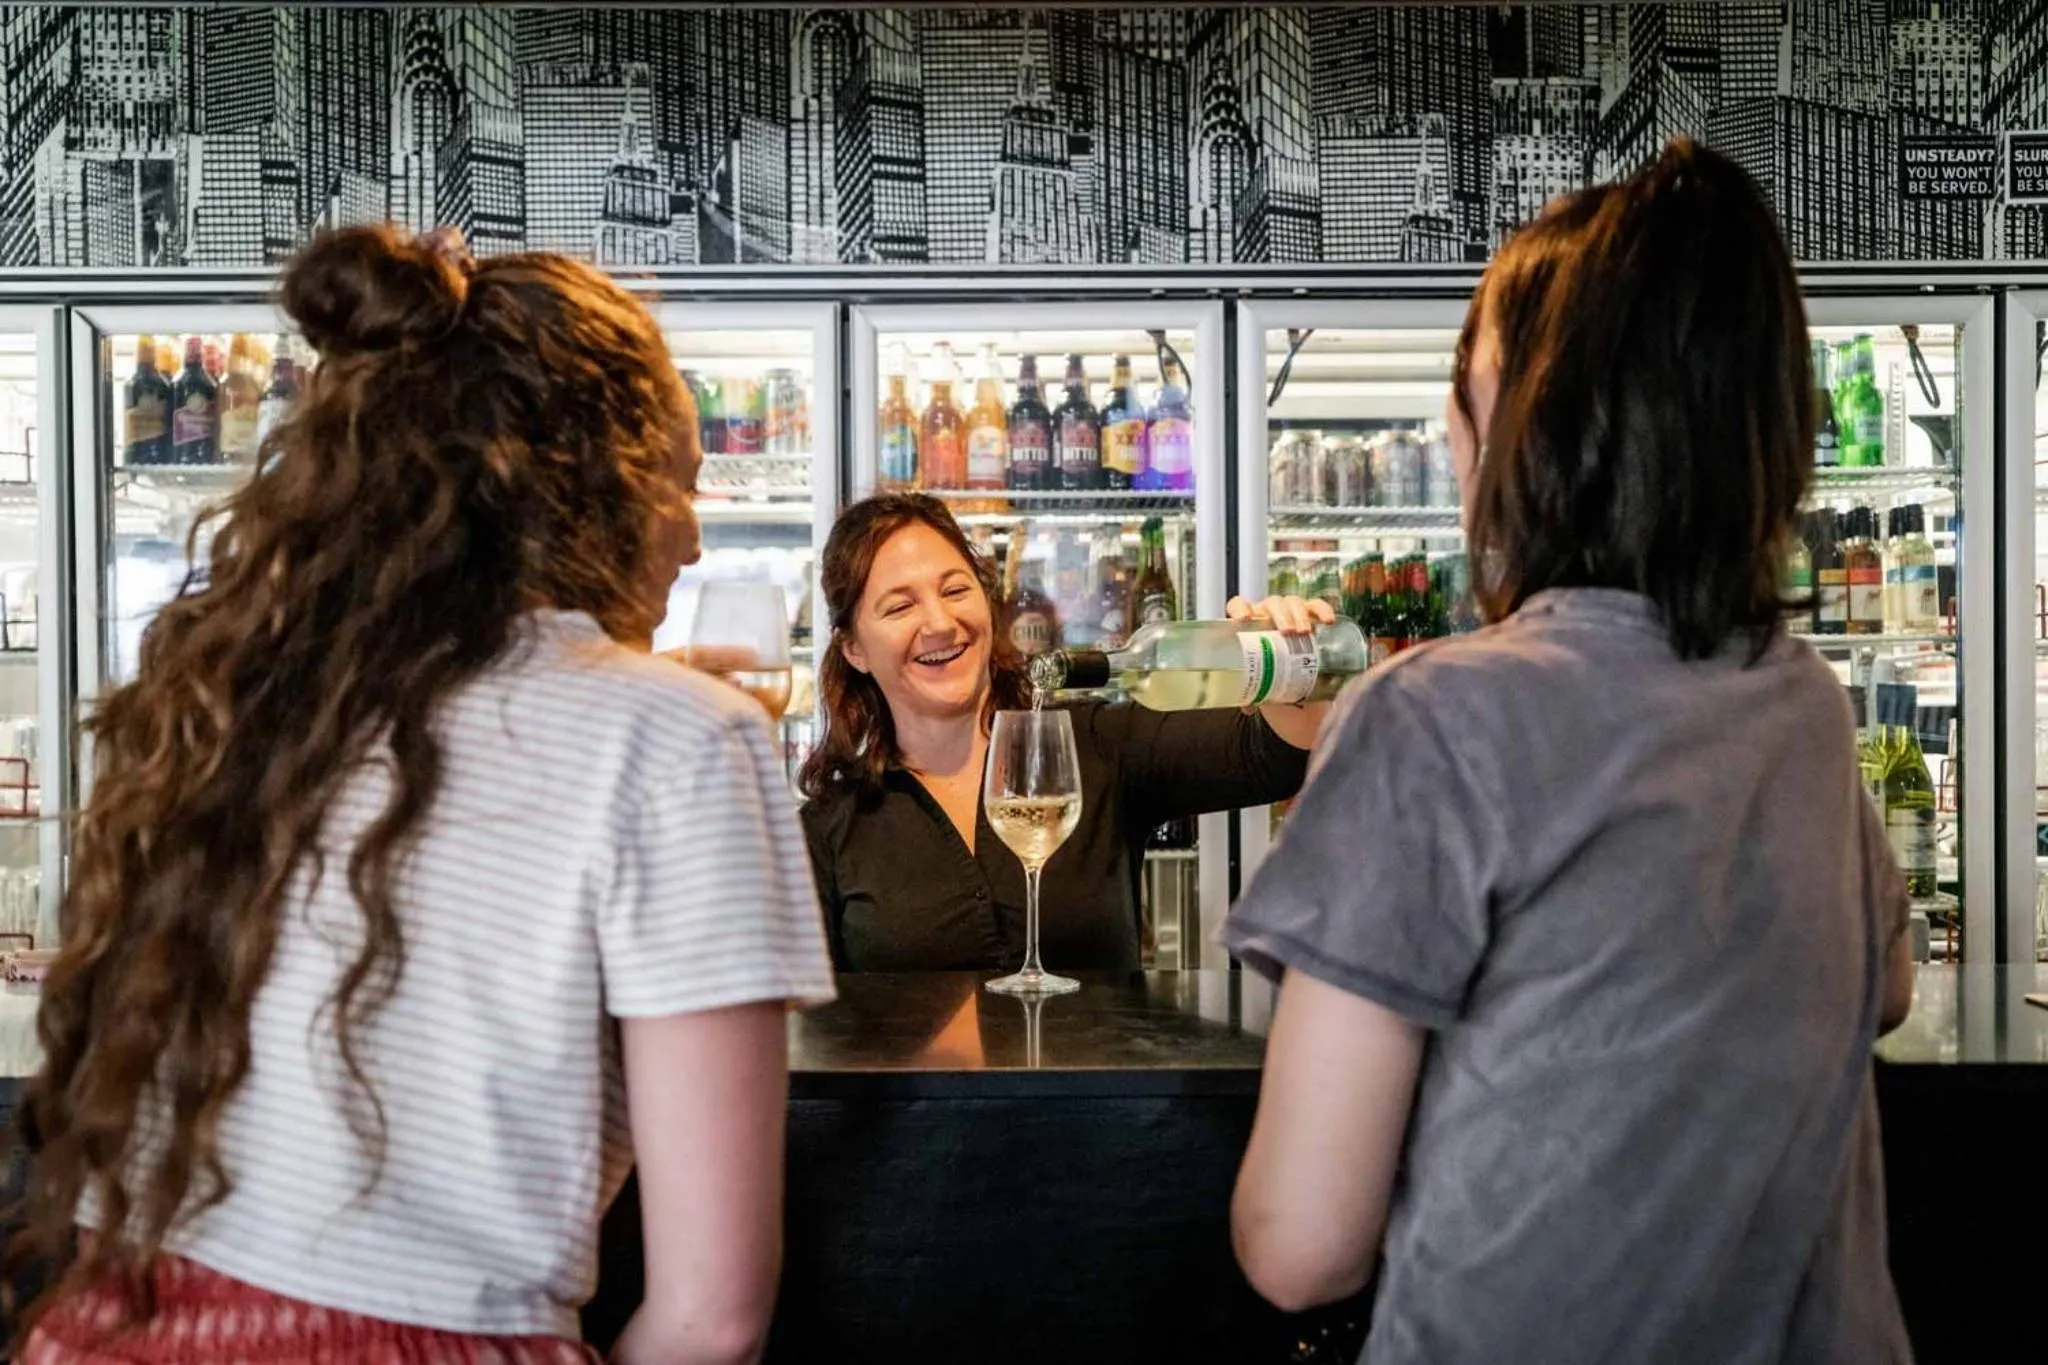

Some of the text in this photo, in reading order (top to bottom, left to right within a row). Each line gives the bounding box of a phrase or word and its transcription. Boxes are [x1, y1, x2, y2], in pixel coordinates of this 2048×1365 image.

[1905, 149, 1995, 162] UNSTEADY?
[1907, 166, 1992, 179] YOU WON'T
[2015, 166, 2042, 178] YOU
[1908, 181, 1992, 194] BE SERVED.
[2017, 179, 2033, 192] BE
